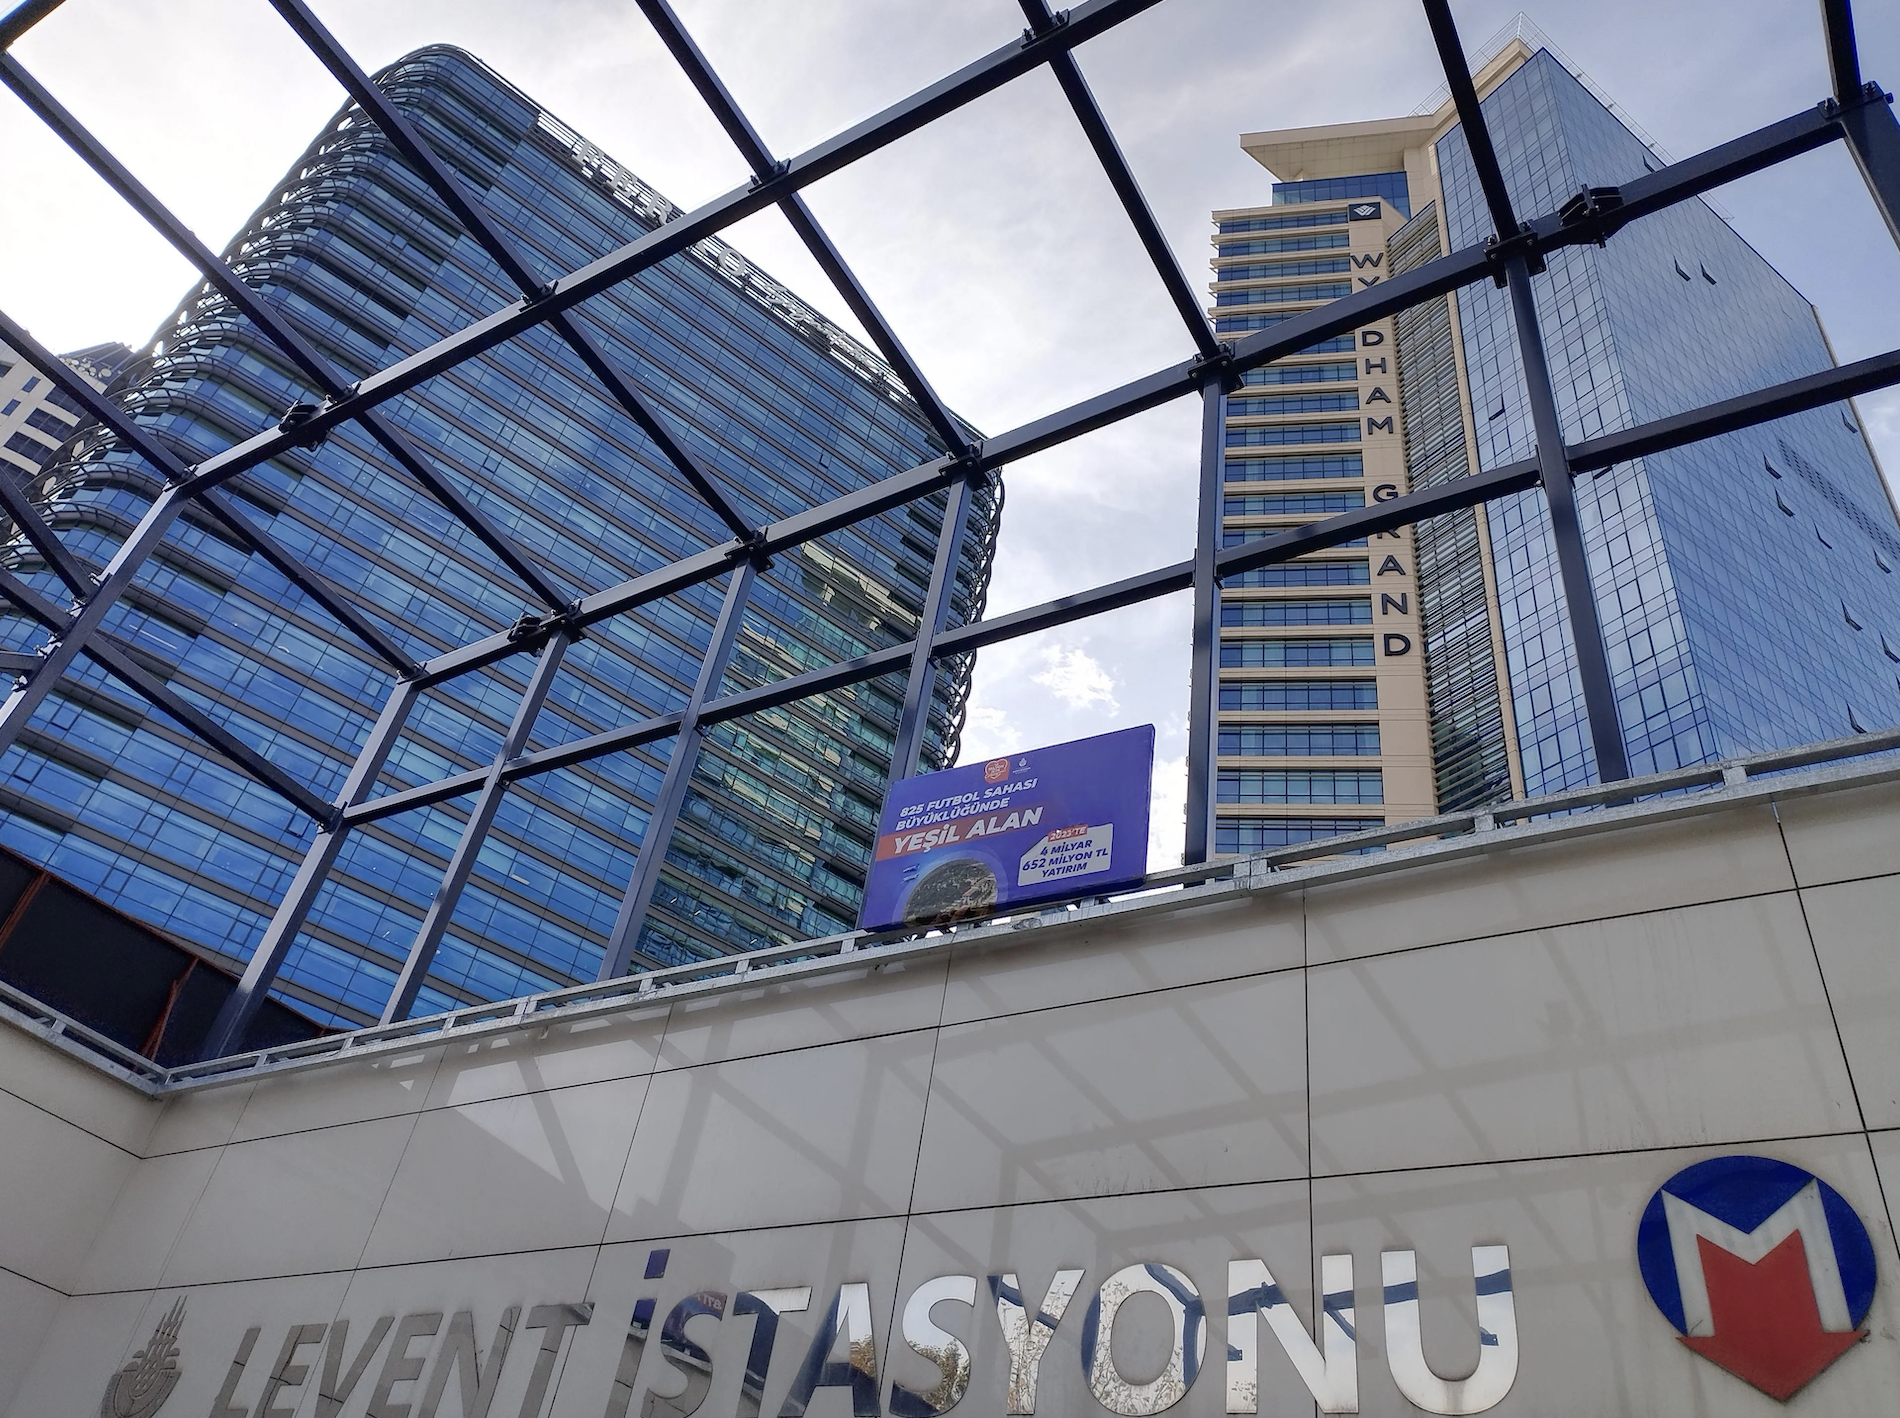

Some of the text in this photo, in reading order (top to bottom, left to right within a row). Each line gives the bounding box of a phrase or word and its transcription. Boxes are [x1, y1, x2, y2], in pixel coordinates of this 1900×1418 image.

[1351, 252, 1394, 435] WYDHAM
[895, 797, 1010, 832] BÜYÜKLÜĞÜNDE
[899, 777, 1038, 818] 825 FUTBOL SAHASI
[893, 807, 1044, 855] YEŞİL ALAN
[1040, 839, 1093, 856] 4 MİLYAR
[1049, 826, 1087, 841] 2023'TE
[1022, 847, 1109, 871] 652 MİLYON TL
[1042, 862, 1088, 878] YATIRIM
[208, 1243, 1520, 1418] LEVENT İSTASYONU
